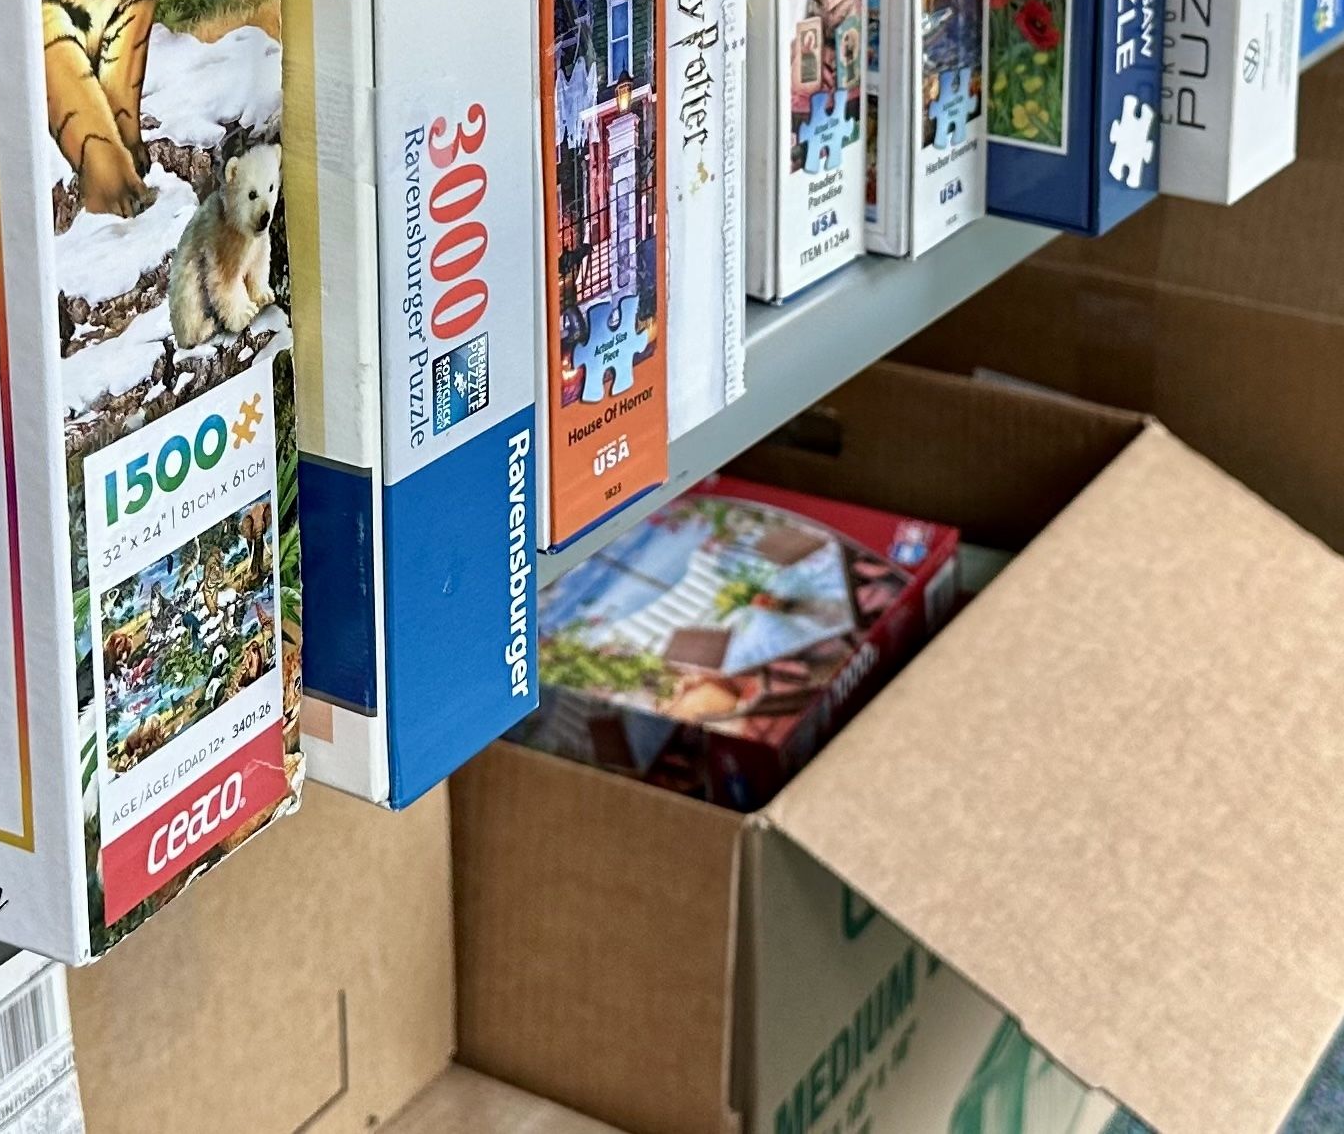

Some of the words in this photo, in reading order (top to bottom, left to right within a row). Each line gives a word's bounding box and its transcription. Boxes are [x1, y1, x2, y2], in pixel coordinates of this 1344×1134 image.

[667, 19, 720, 154] Potter
[808, 169, 844, 196] Reader's
[808, 185, 843, 210] Paradise
[939, 179, 963, 205] USA
[428, 103, 488, 340] 3000
[811, 210, 839, 237] USA
[800, 244, 822, 266] ITEM
[594, 338, 614, 357] Actual
[615, 331, 628, 346] Size
[602, 348, 619, 365] Piece
[408, 346, 430, 449] Puzzle
[442, 355, 451, 426] SOFTCLICK
[467, 341, 479, 415] PUZZLE
[477, 336, 487, 409] PREMIUM
[568, 416, 603, 447] House
[604, 406, 617, 424] Of
[619, 386, 654, 414] Horror
[105, 414, 228, 526] 1500
[593, 440, 630, 476] USA
[103, 534, 127, 568] 32"
[143, 513, 167, 543] 24"
[506, 426, 531, 699] Ravensburger
[209, 737, 226, 755] 12+
[232, 702, 272, 739] 3401-26
